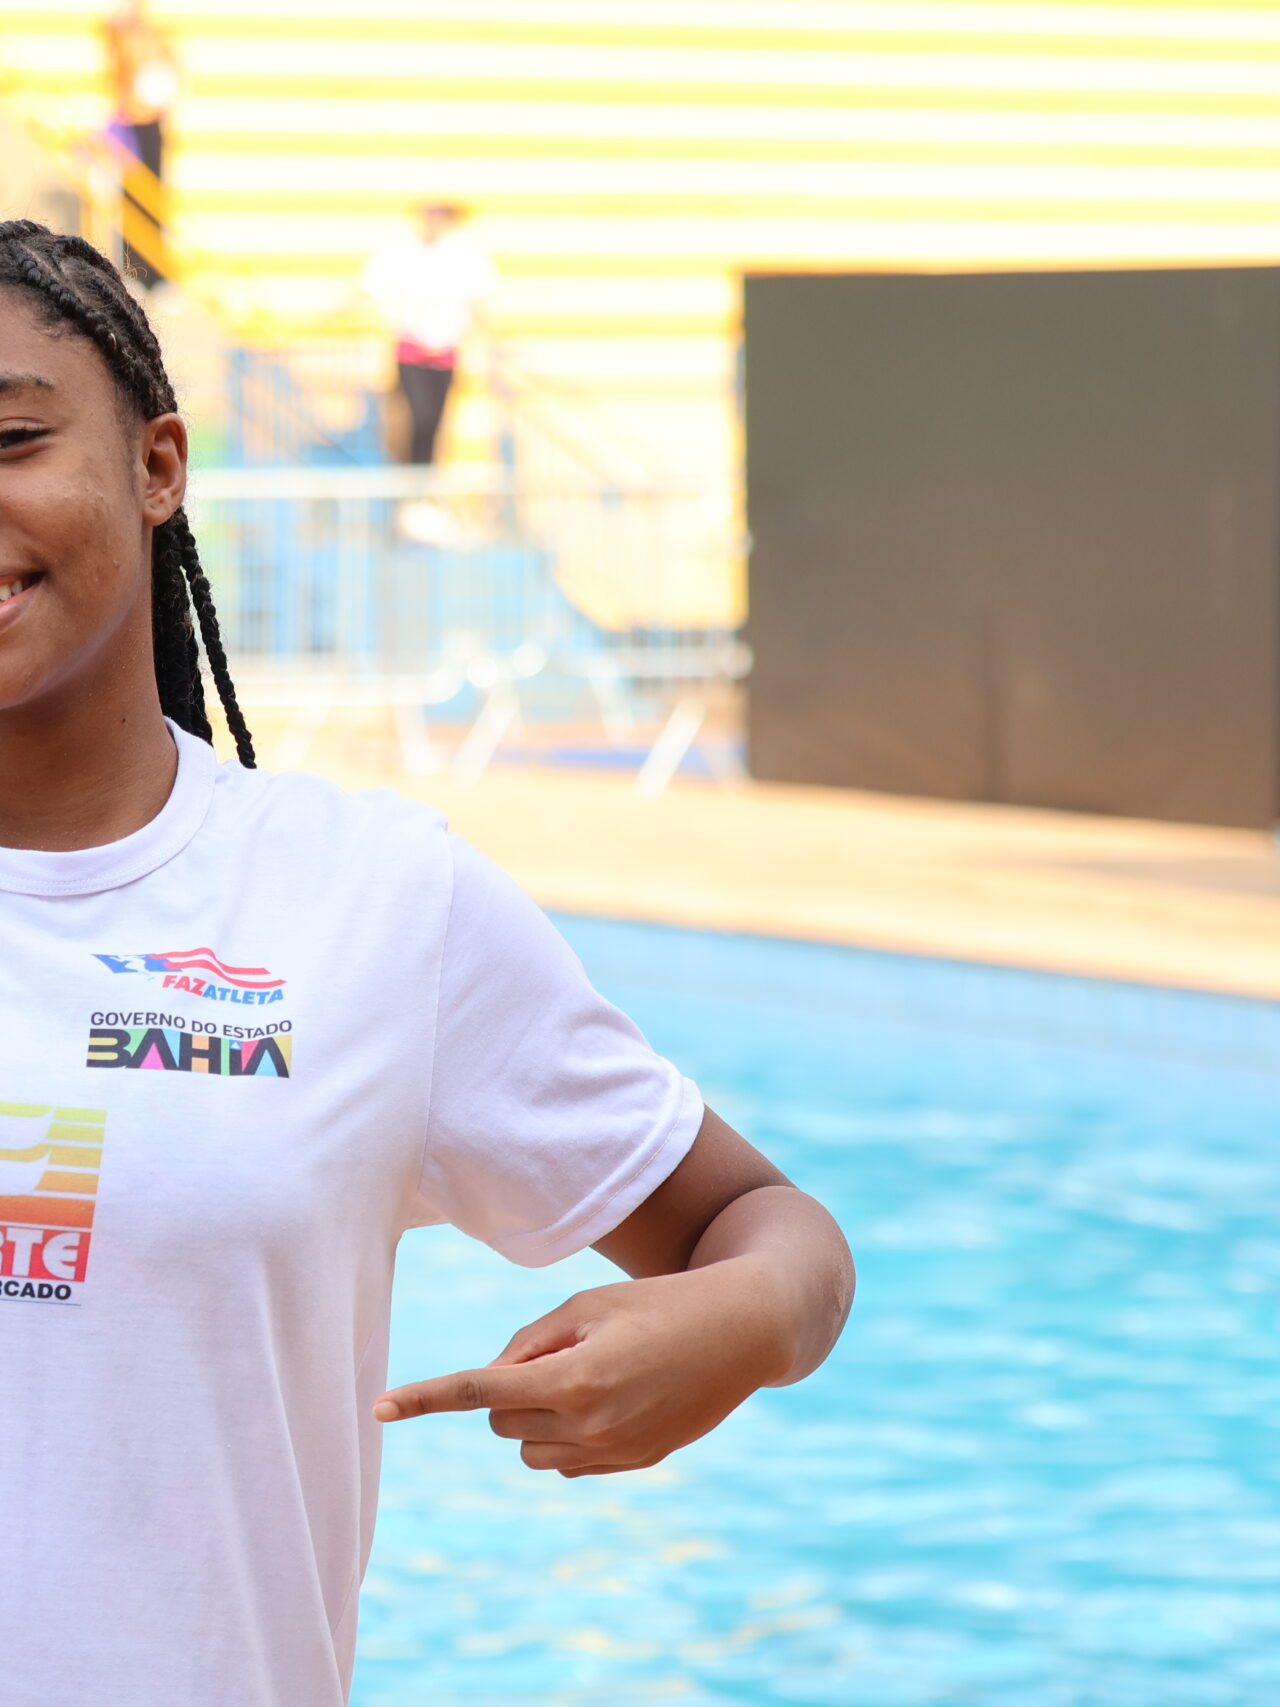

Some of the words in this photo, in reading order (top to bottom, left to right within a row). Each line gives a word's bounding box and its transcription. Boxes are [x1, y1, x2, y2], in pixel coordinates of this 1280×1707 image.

[90, 1011, 186, 1029] GOVERNO
[191, 1020, 217, 1034] DO
[223, 1020, 293, 1039] ESTADO
[86, 1028, 291, 1078] BAHIA
